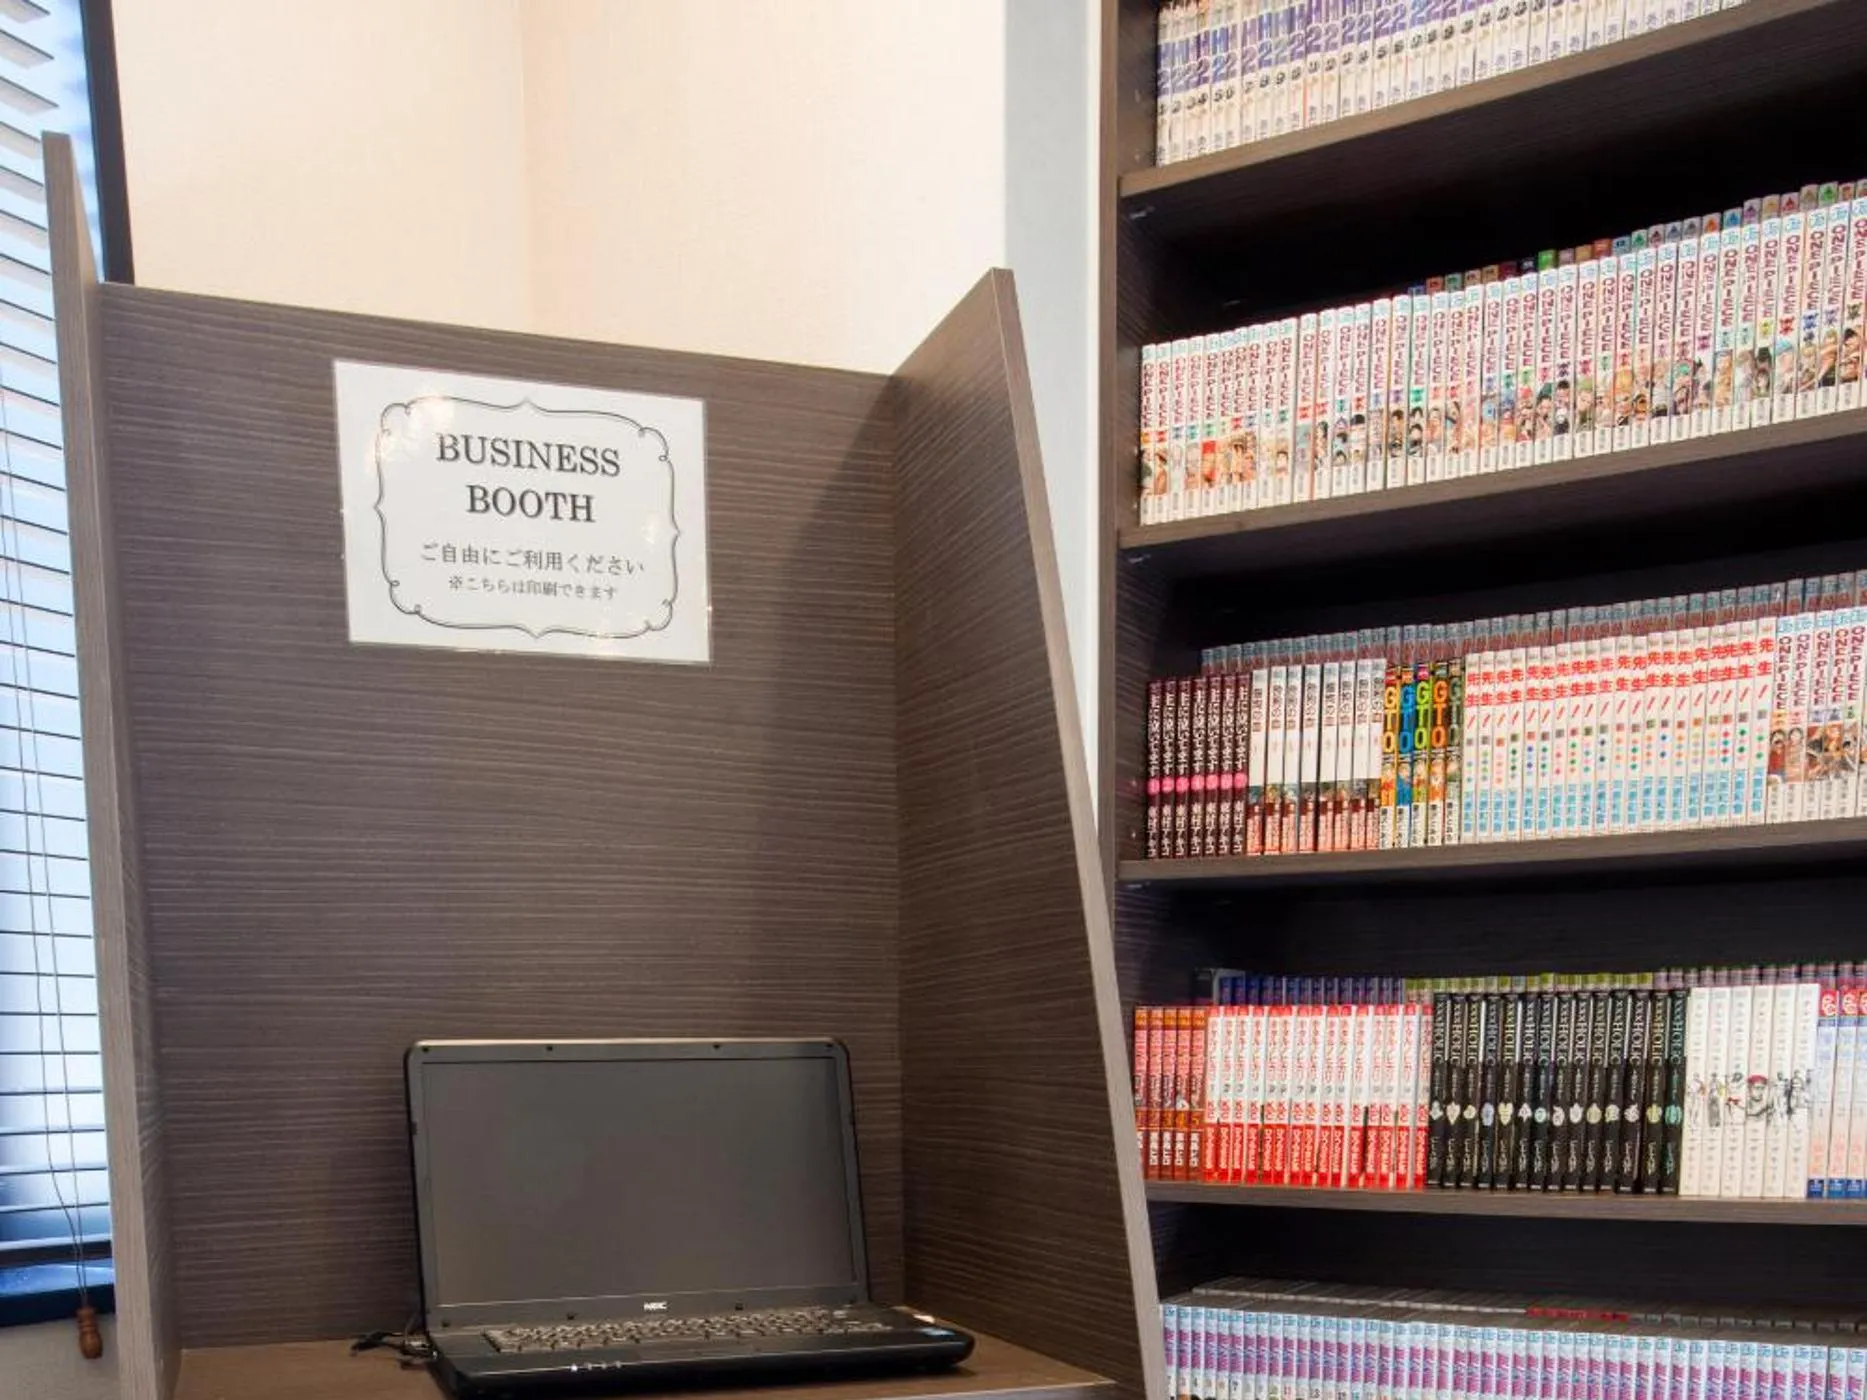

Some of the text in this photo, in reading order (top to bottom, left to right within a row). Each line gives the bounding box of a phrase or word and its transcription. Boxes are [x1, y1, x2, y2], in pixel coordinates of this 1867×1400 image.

[437, 432, 621, 477] BUSINESS
[466, 485, 595, 523] BOOTH
[421, 542, 645, 575] ご自由にご利用ください
[1385, 687, 1396, 753] GTO
[1400, 686, 1413, 752] GTO
[1415, 681, 1429, 747] GTO
[1432, 681, 1448, 748] GTO
